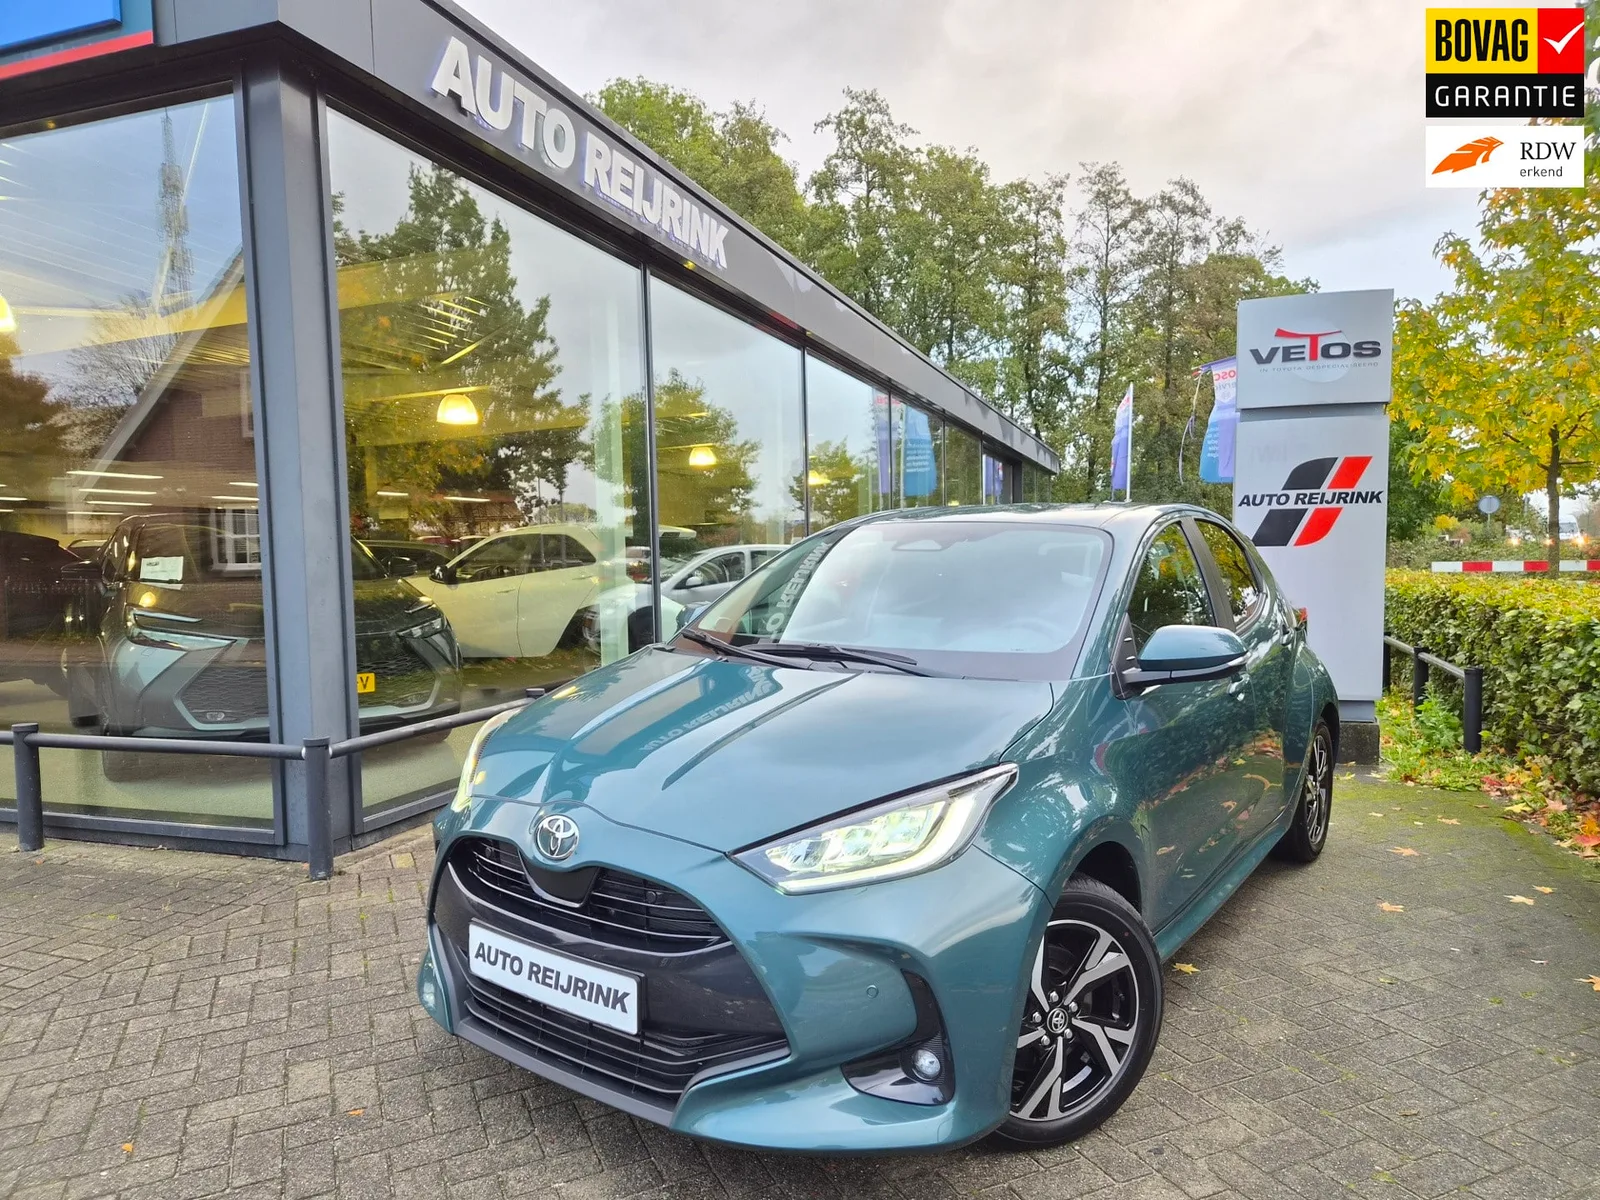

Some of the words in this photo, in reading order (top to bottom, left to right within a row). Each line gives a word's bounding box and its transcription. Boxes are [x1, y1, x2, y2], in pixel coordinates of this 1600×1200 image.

[431, 36, 576, 169] AUTO
[583, 131, 729, 269] REIJRINK
[1249, 328, 1382, 364] VETOS
[1238, 493, 1290, 507] AUTO
[1294, 490, 1384, 505] REIJRINK
[474, 942, 523, 976] AUTO
[528, 961, 630, 1014] REIJRINK
